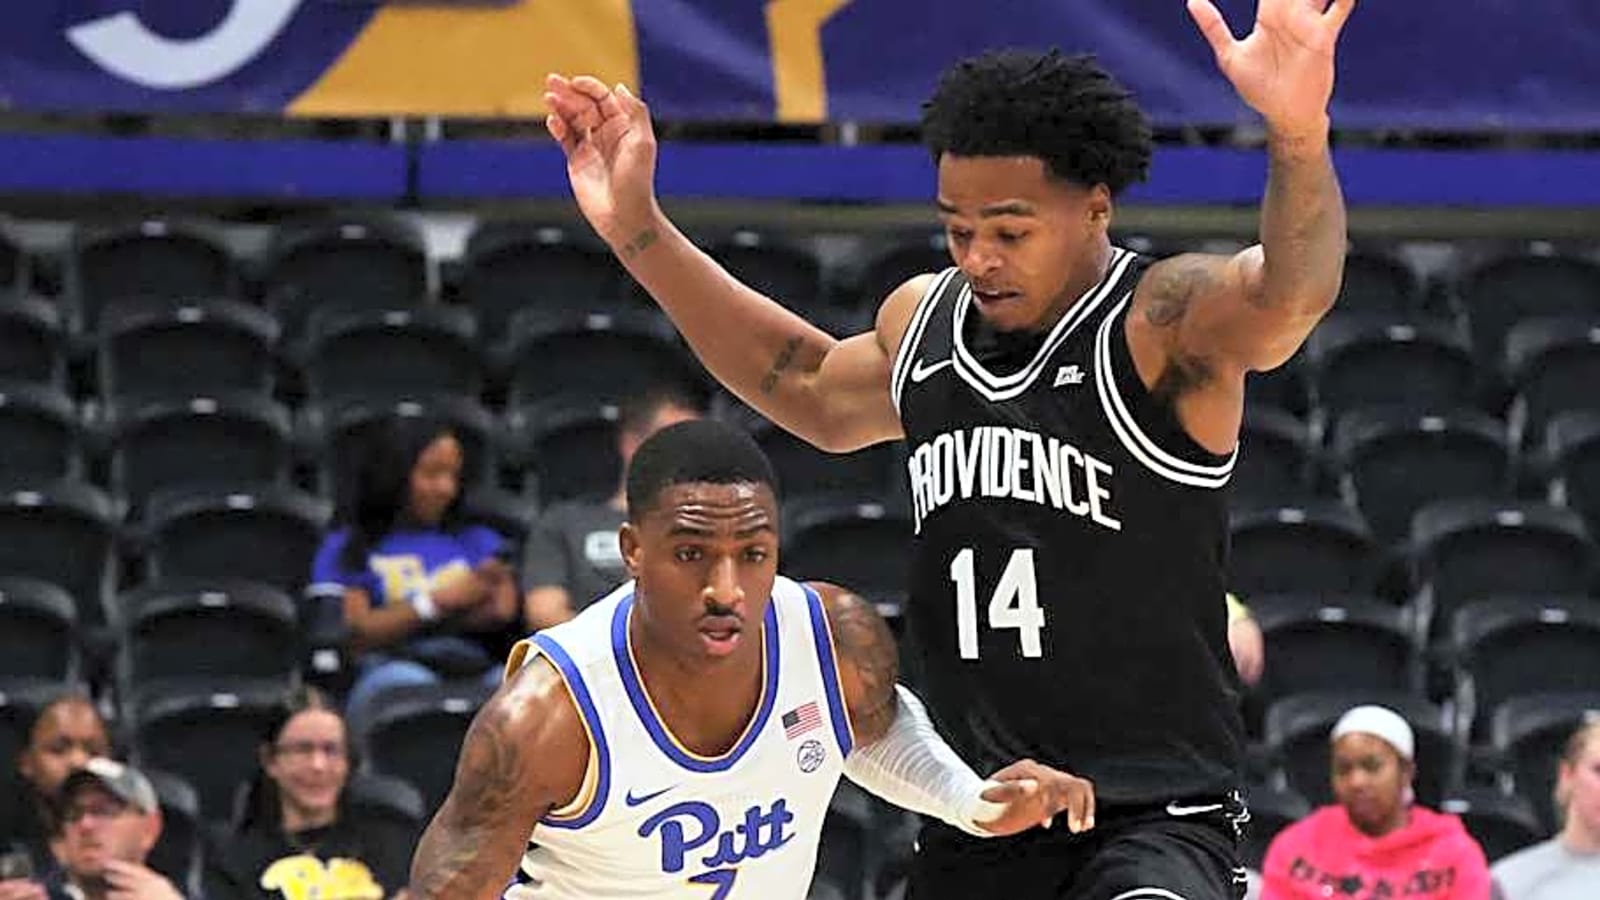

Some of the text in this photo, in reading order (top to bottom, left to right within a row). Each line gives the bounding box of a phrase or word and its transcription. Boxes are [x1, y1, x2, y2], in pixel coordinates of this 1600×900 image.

[908, 426, 1121, 534] PROVIDENCE
[951, 548, 1045, 659] 14
[638, 799, 796, 873] Pitt
